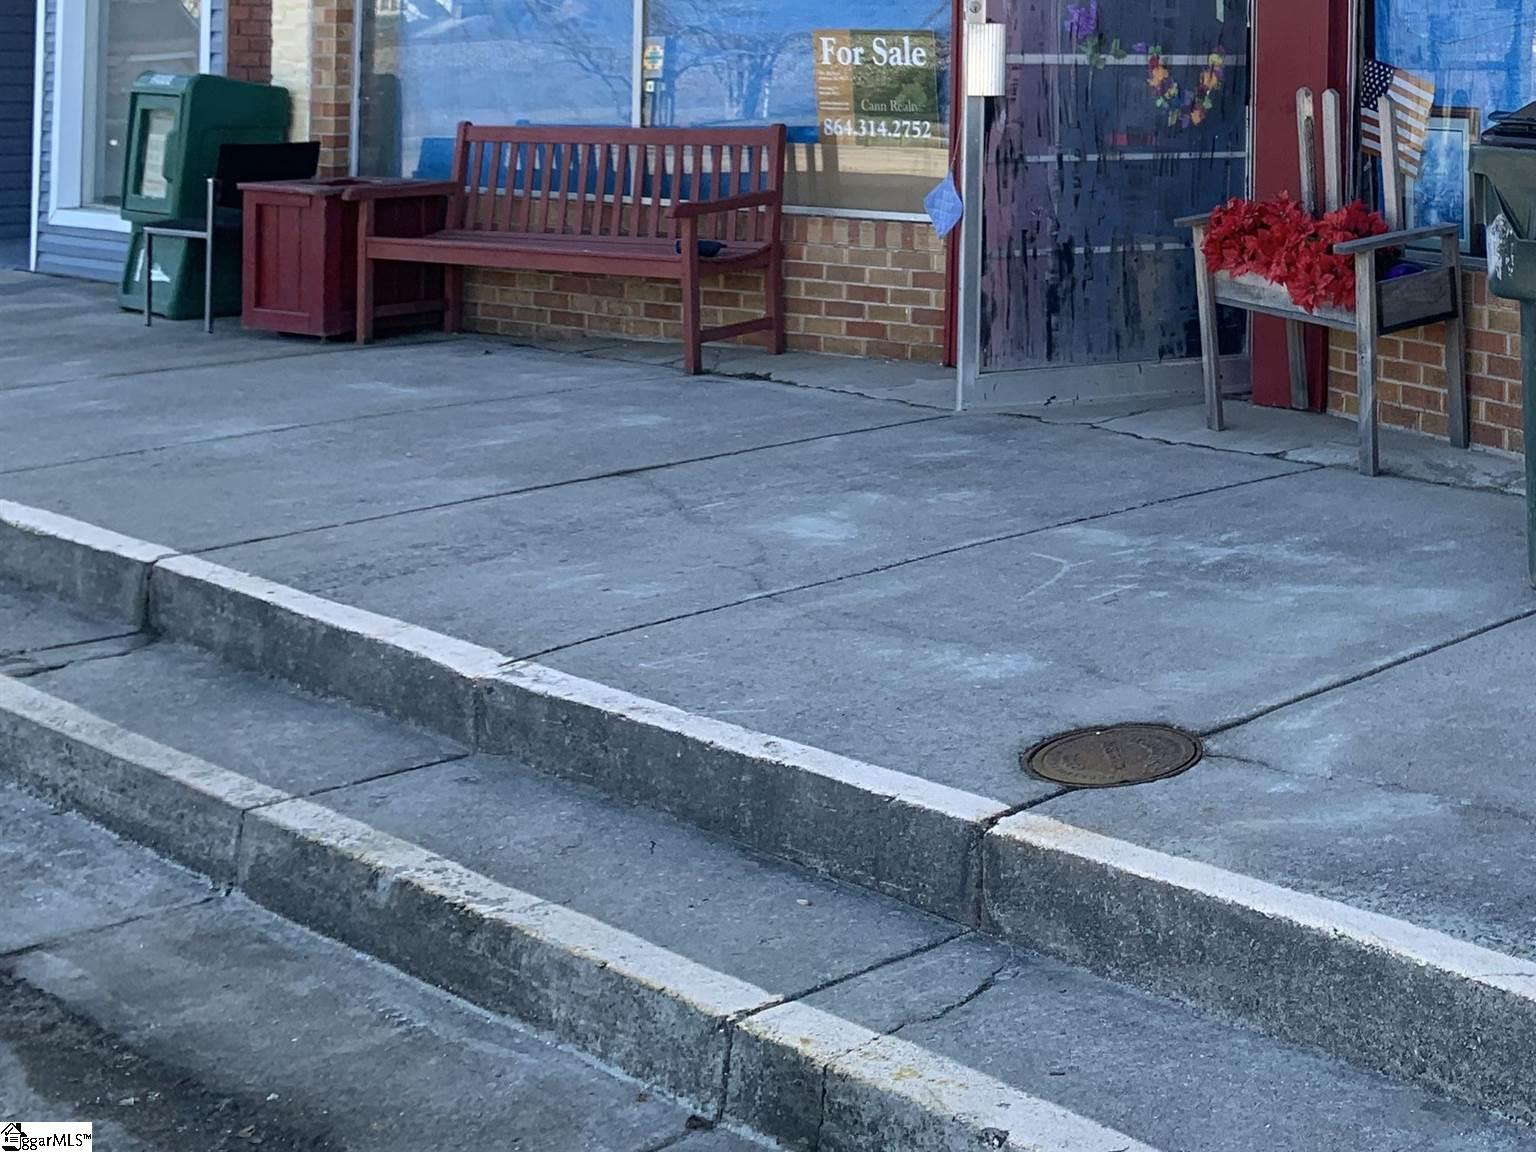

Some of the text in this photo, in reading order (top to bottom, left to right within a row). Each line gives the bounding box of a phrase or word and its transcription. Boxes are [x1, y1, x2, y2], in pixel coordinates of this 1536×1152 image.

[819, 36, 927, 66] For Sale
[823, 118, 932, 138] 864.314.2752
